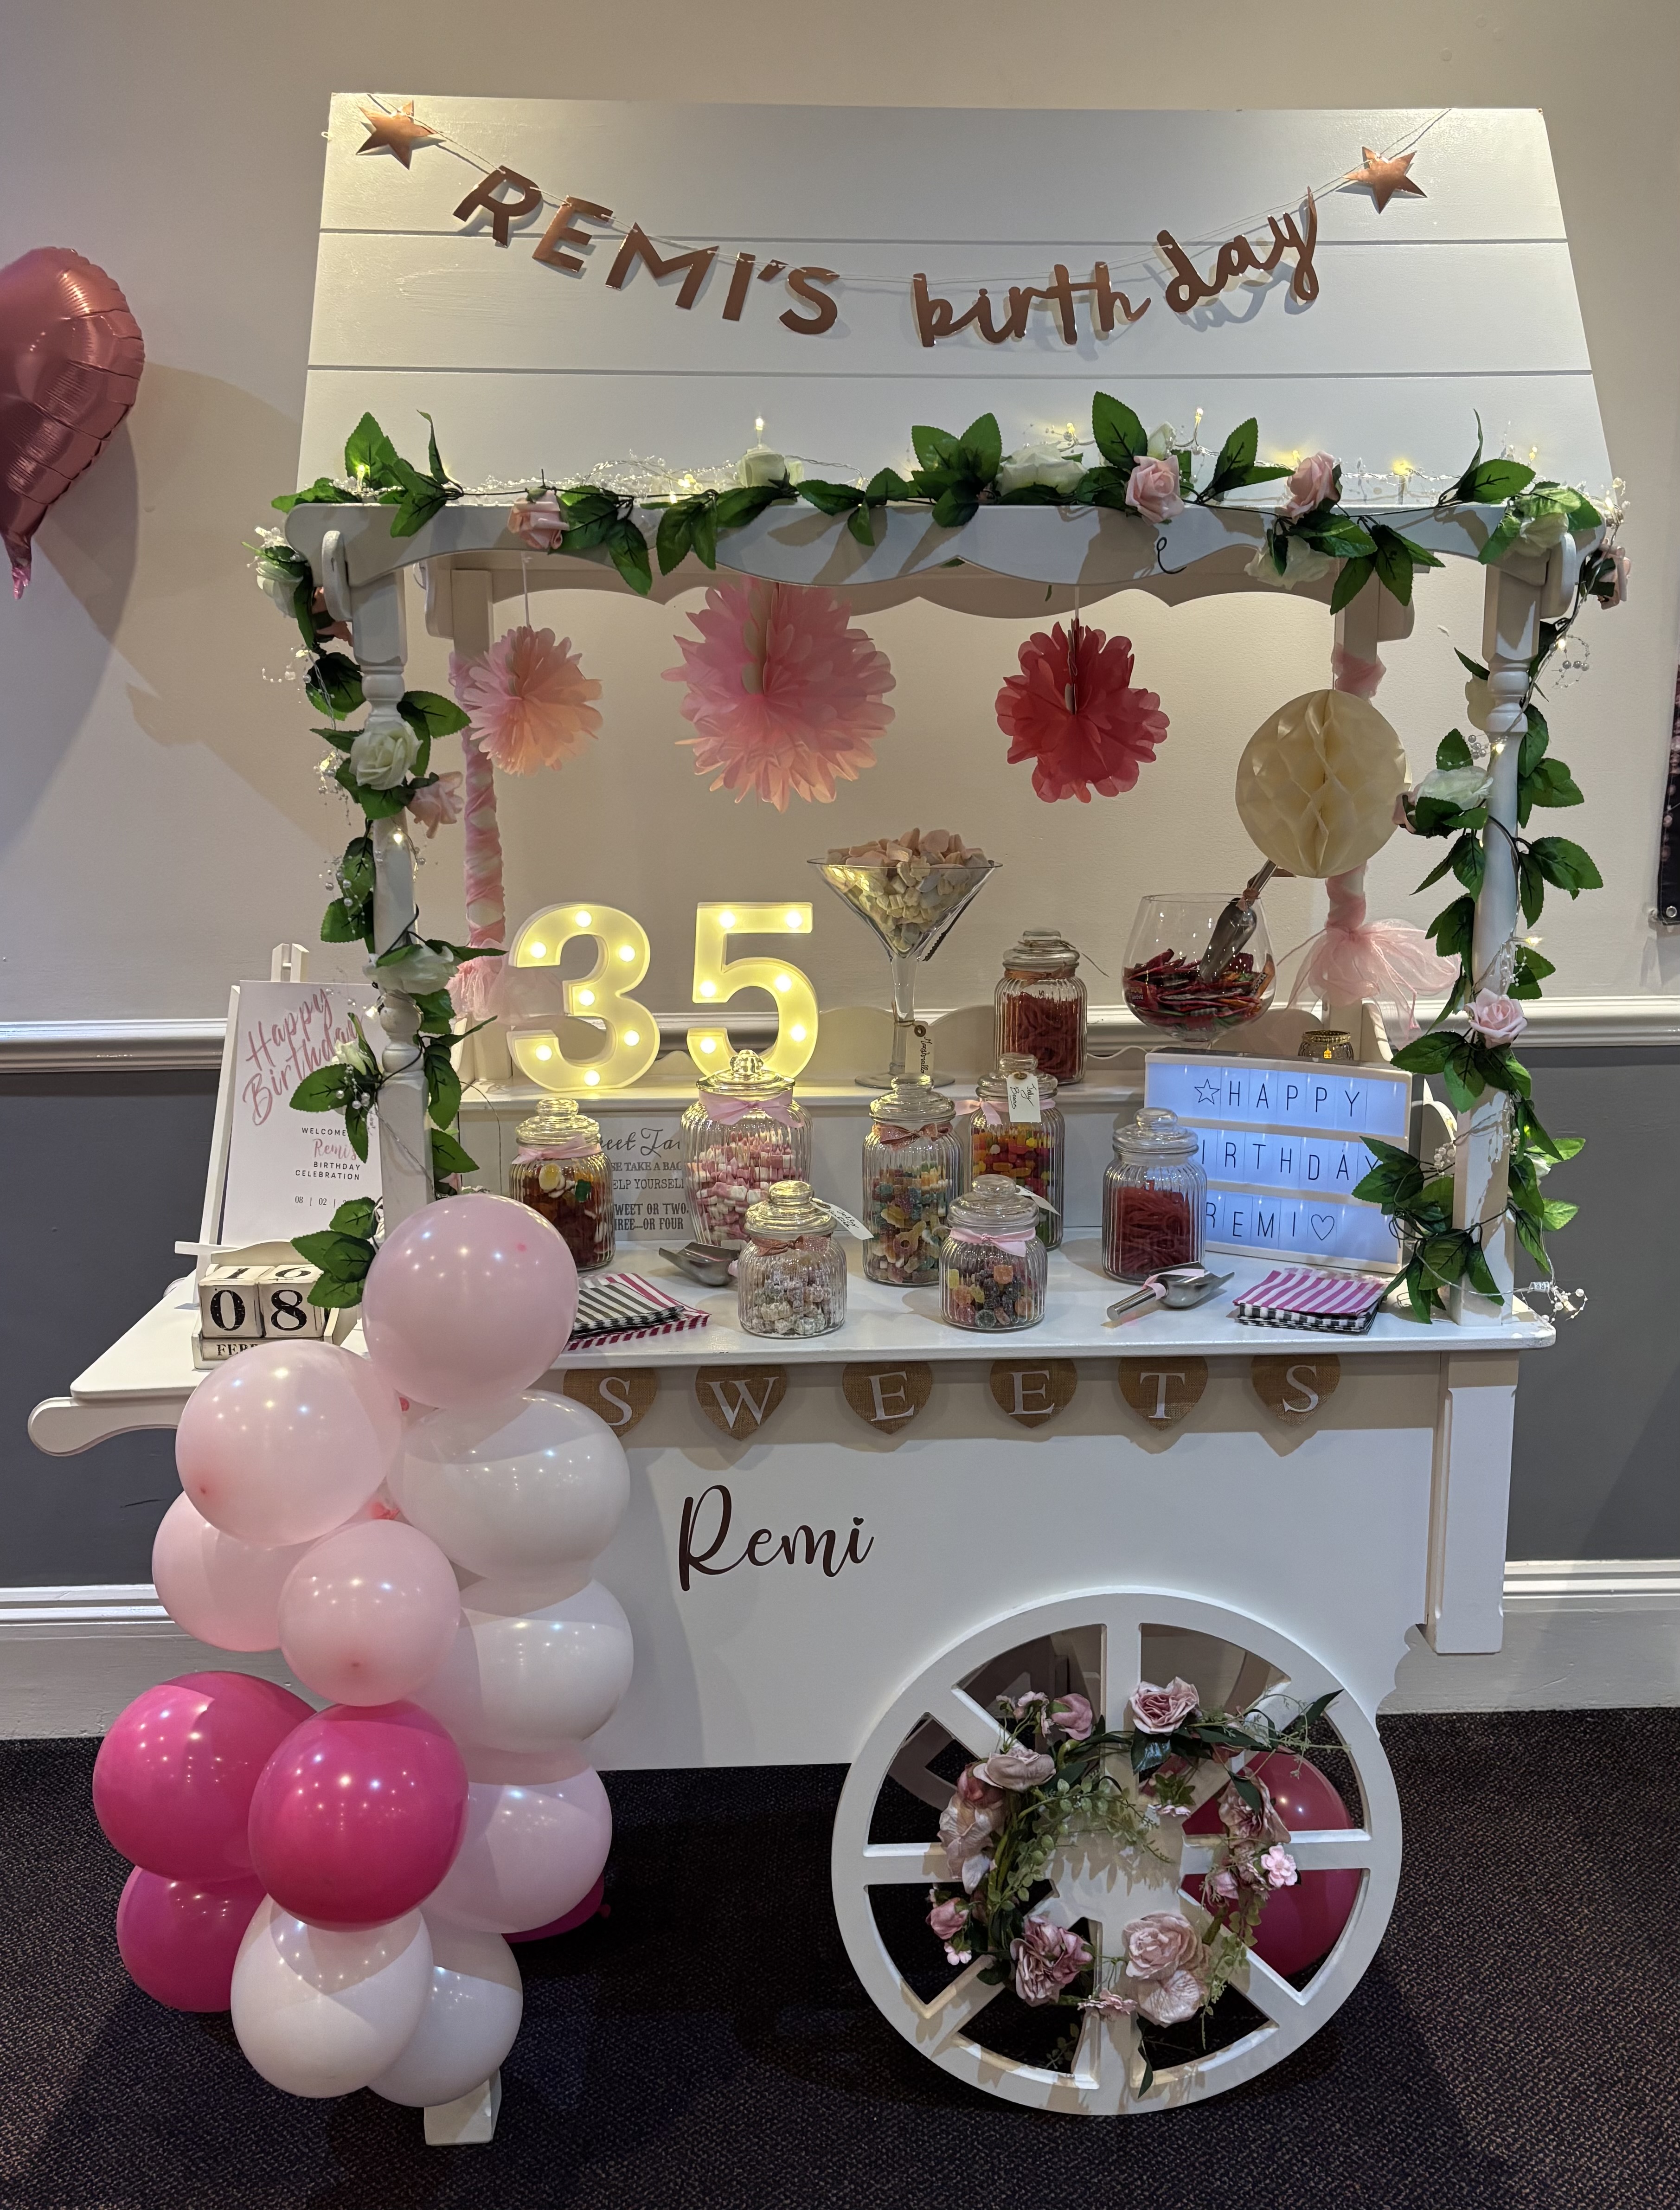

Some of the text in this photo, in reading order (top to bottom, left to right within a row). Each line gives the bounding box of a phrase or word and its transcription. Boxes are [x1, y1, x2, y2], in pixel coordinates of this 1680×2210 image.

[453, 164, 840, 336] REMI'S
[245, 988, 333, 1071] Happy
[920, 1036, 933, 1073] Marshmallo
[1009, 1086, 1020, 1109] Beans
[1020, 1083, 1037, 1106] Jelly
[1229, 1080, 1360, 1117] HAPPY
[301, 1127, 347, 1136] WELCOME
[314, 1161, 360, 1171] BIRTHDAY
[624, 1162, 651, 1171] TAKE
[653, 1162, 660, 1171] A
[1202, 1139, 1379, 1181] IRTHDAY
[295, 1169, 359, 1180] CELEBRATION
[613, 1179, 631, 1190] ELP
[614, 1203, 643, 1215] WEET
[647, 1203, 659, 1215] OR
[1206, 1202, 1296, 1239] REMI
[659, 1217, 684, 1230] FOUR
[678, 1484, 874, 1591] Remi
